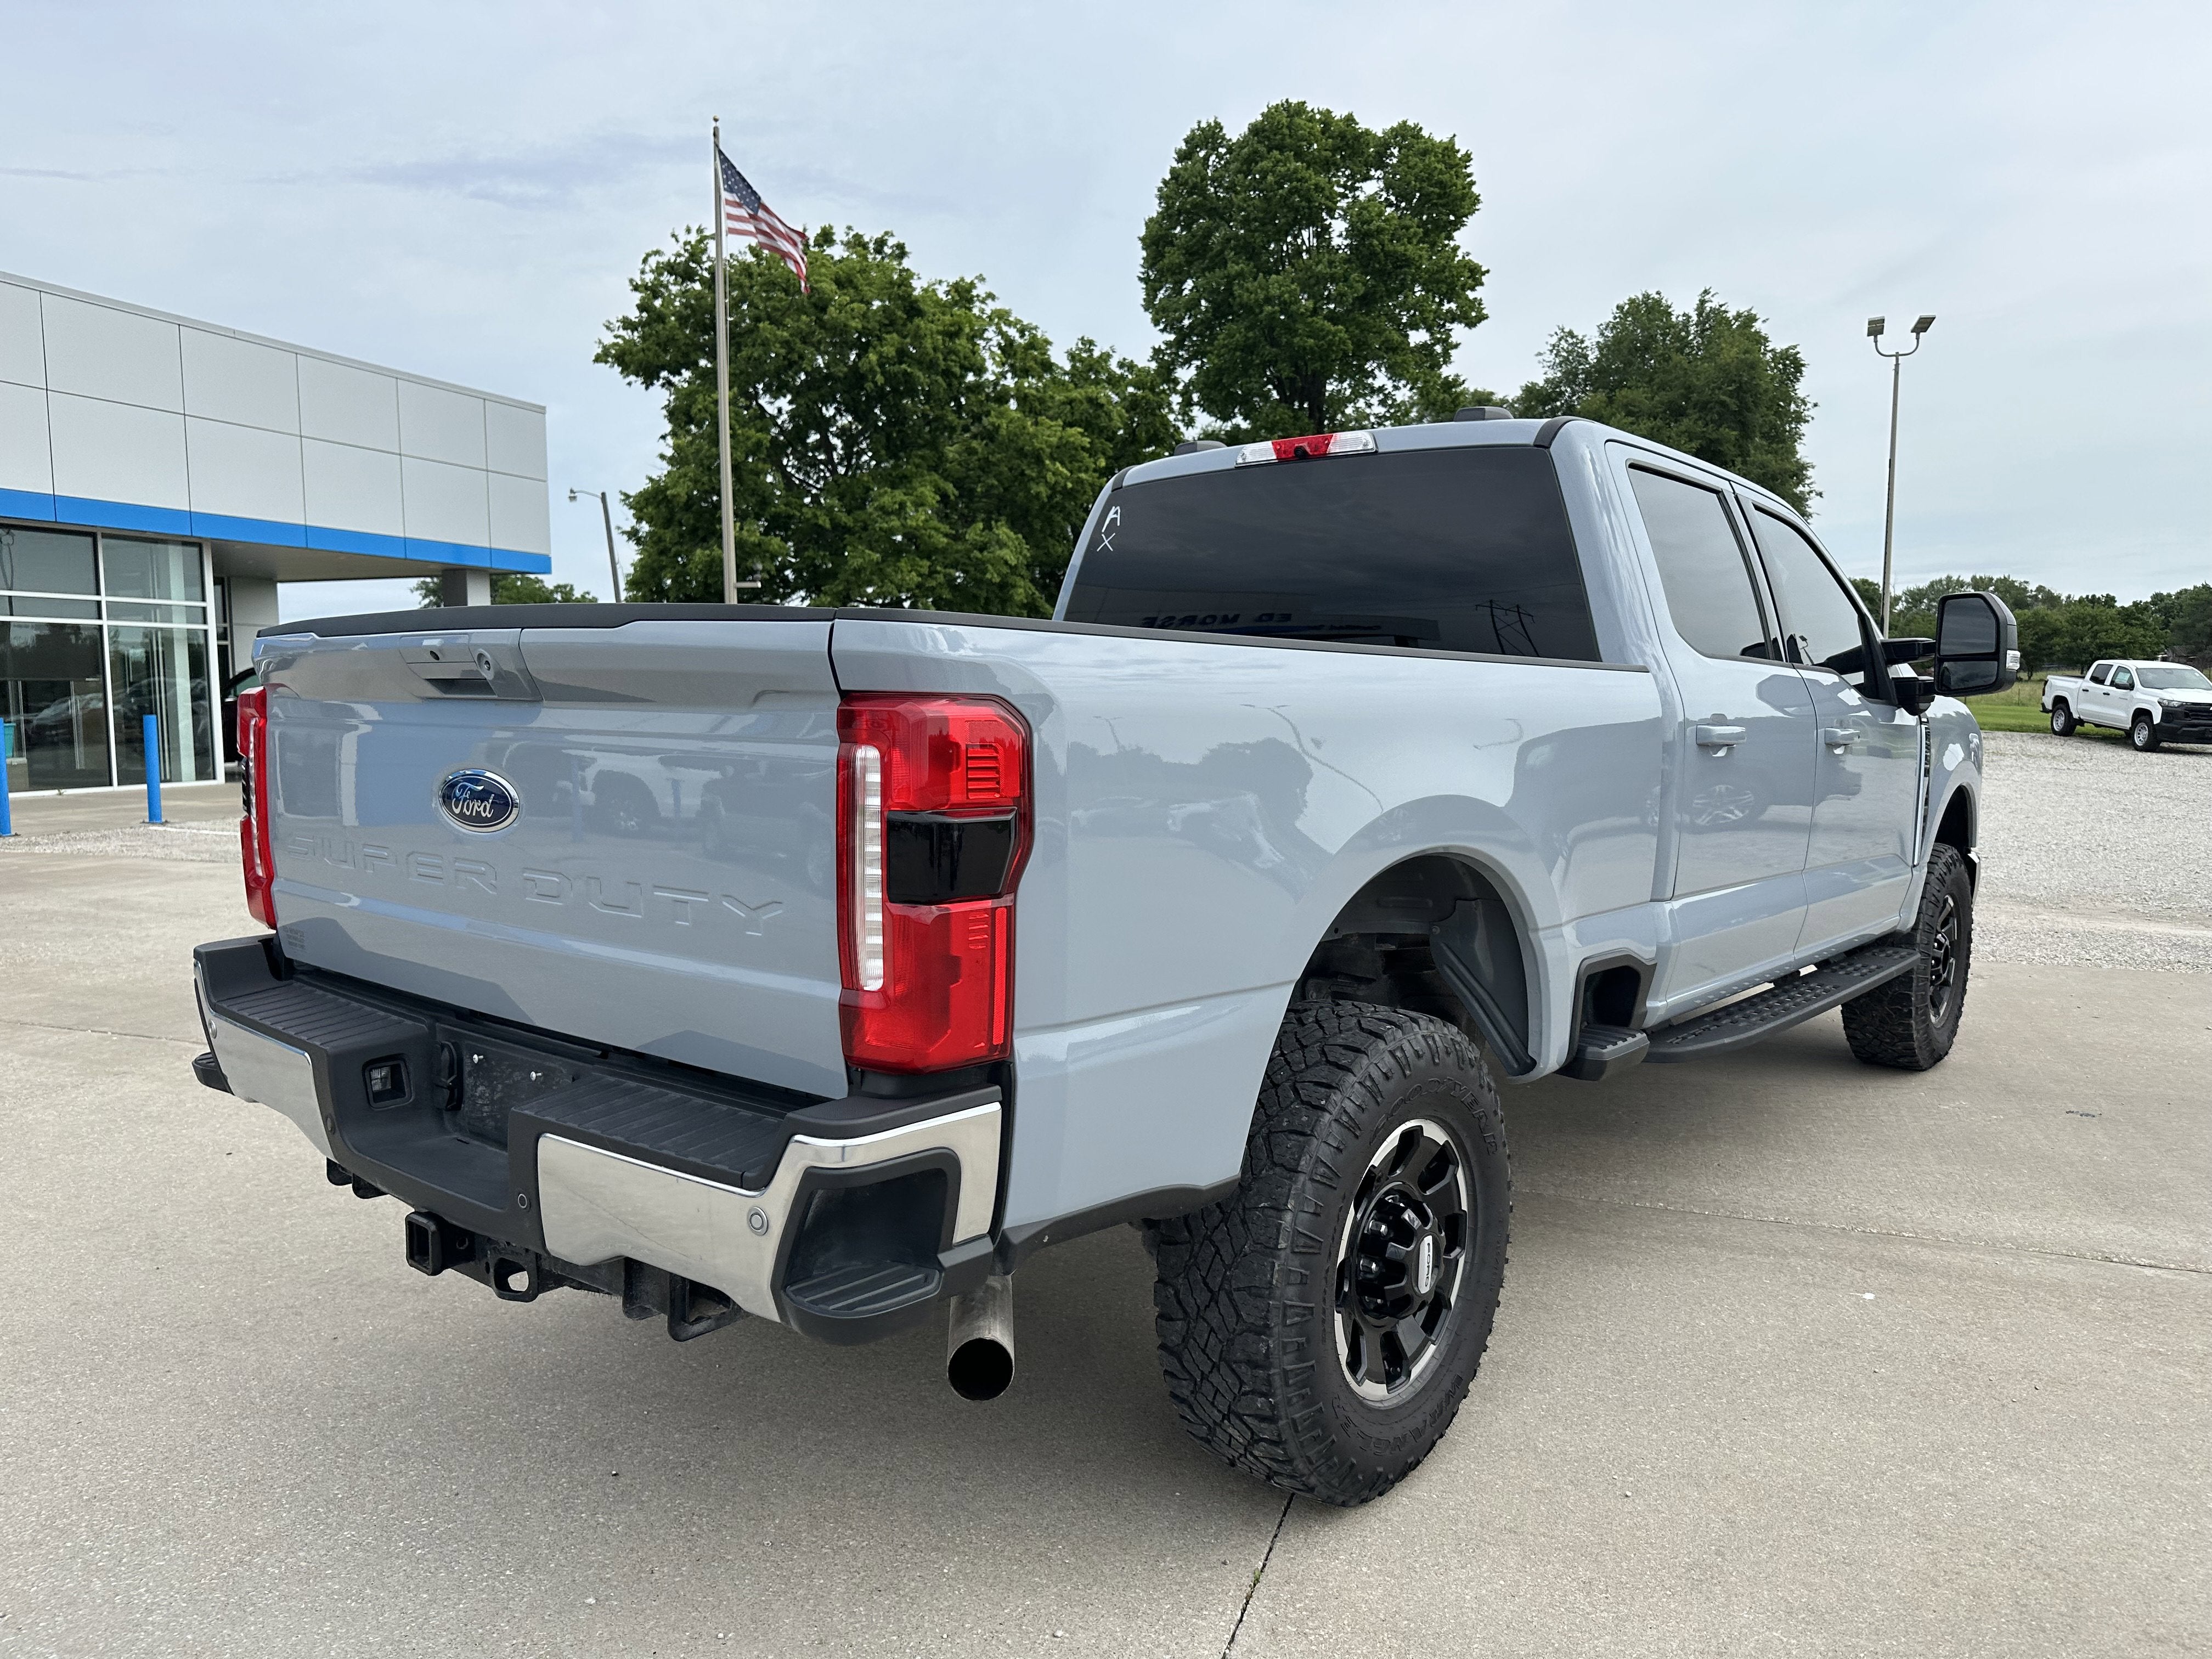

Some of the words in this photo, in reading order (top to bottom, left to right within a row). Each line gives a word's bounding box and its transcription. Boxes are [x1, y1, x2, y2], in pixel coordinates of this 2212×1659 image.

[452, 782, 495, 817] Ford
[286, 836, 498, 895] SUPER
[522, 867, 783, 936] DUTY
[1369, 1076, 1497, 1156] GOODYEAR
